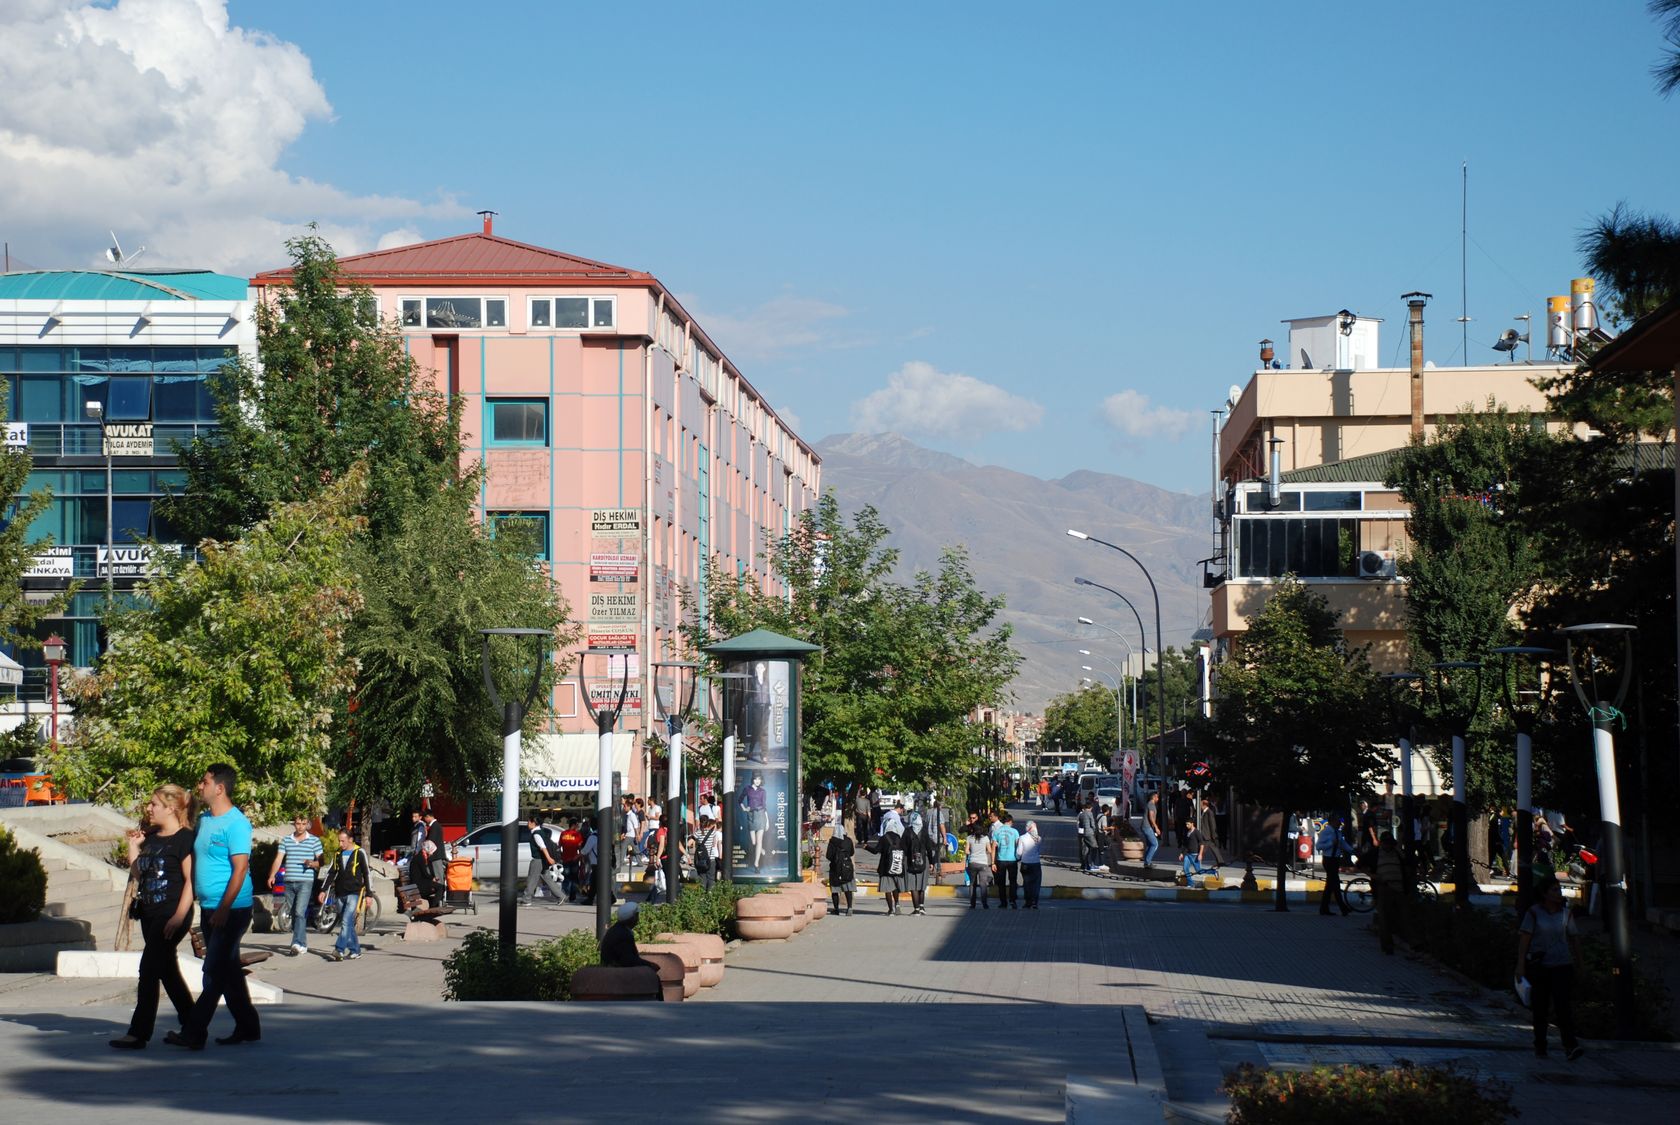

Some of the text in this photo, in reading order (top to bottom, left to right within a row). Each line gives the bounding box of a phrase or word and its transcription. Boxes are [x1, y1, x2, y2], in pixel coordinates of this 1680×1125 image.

[105, 425, 153, 437] AVUKAT
[593, 509, 637, 522] DİŞ HEKİMİ
[613, 522, 638, 530] ERDAL
[592, 595, 636, 607] DİŞ HEKİMİ
[592, 607, 636, 616] Özer YILMAZ
[775, 792, 788, 839] selesepet
